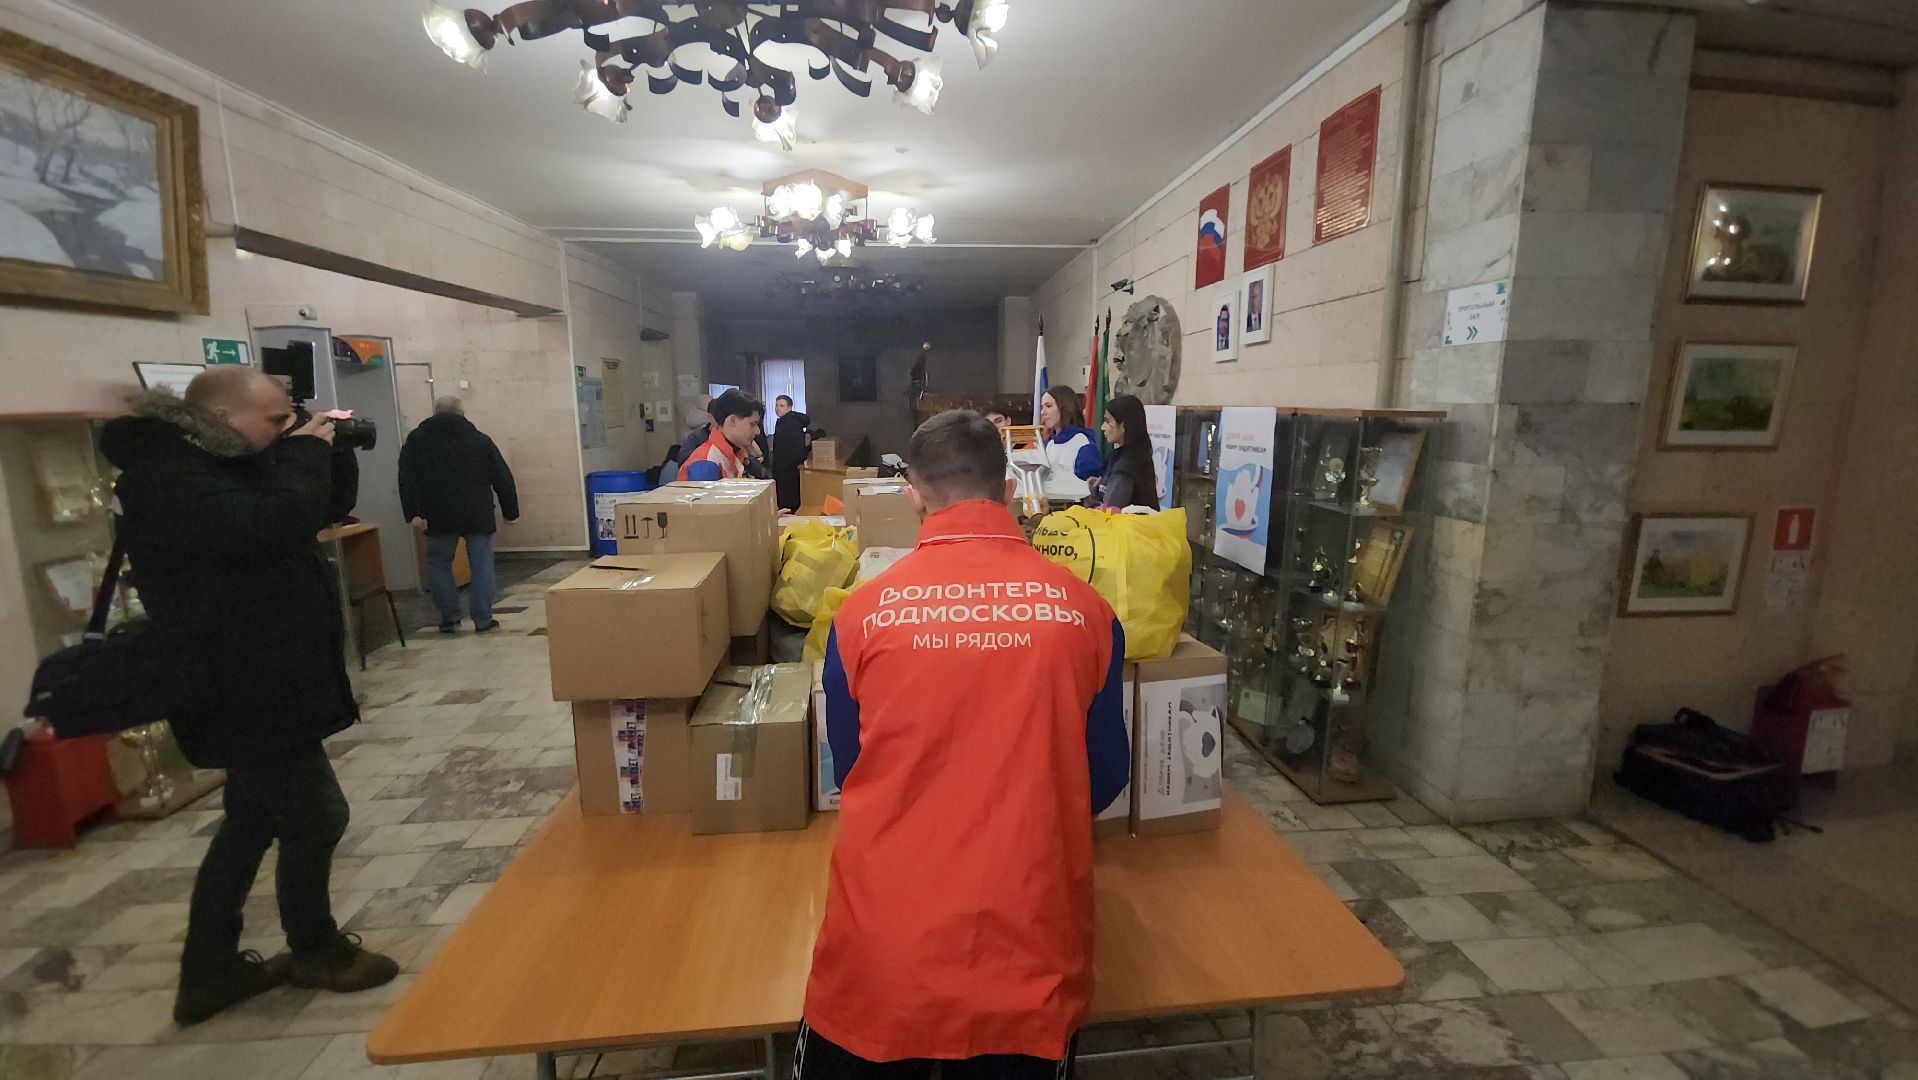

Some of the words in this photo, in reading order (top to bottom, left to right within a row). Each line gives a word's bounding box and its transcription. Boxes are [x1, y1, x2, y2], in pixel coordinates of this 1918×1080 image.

[878, 581, 1068, 607] ВОЛОНТЕРЫ
[862, 603, 1086, 639] ПОДМОСКОВЬЯ
[913, 632, 949, 650] МЫ
[955, 632, 1032, 650] РЯДОМ
